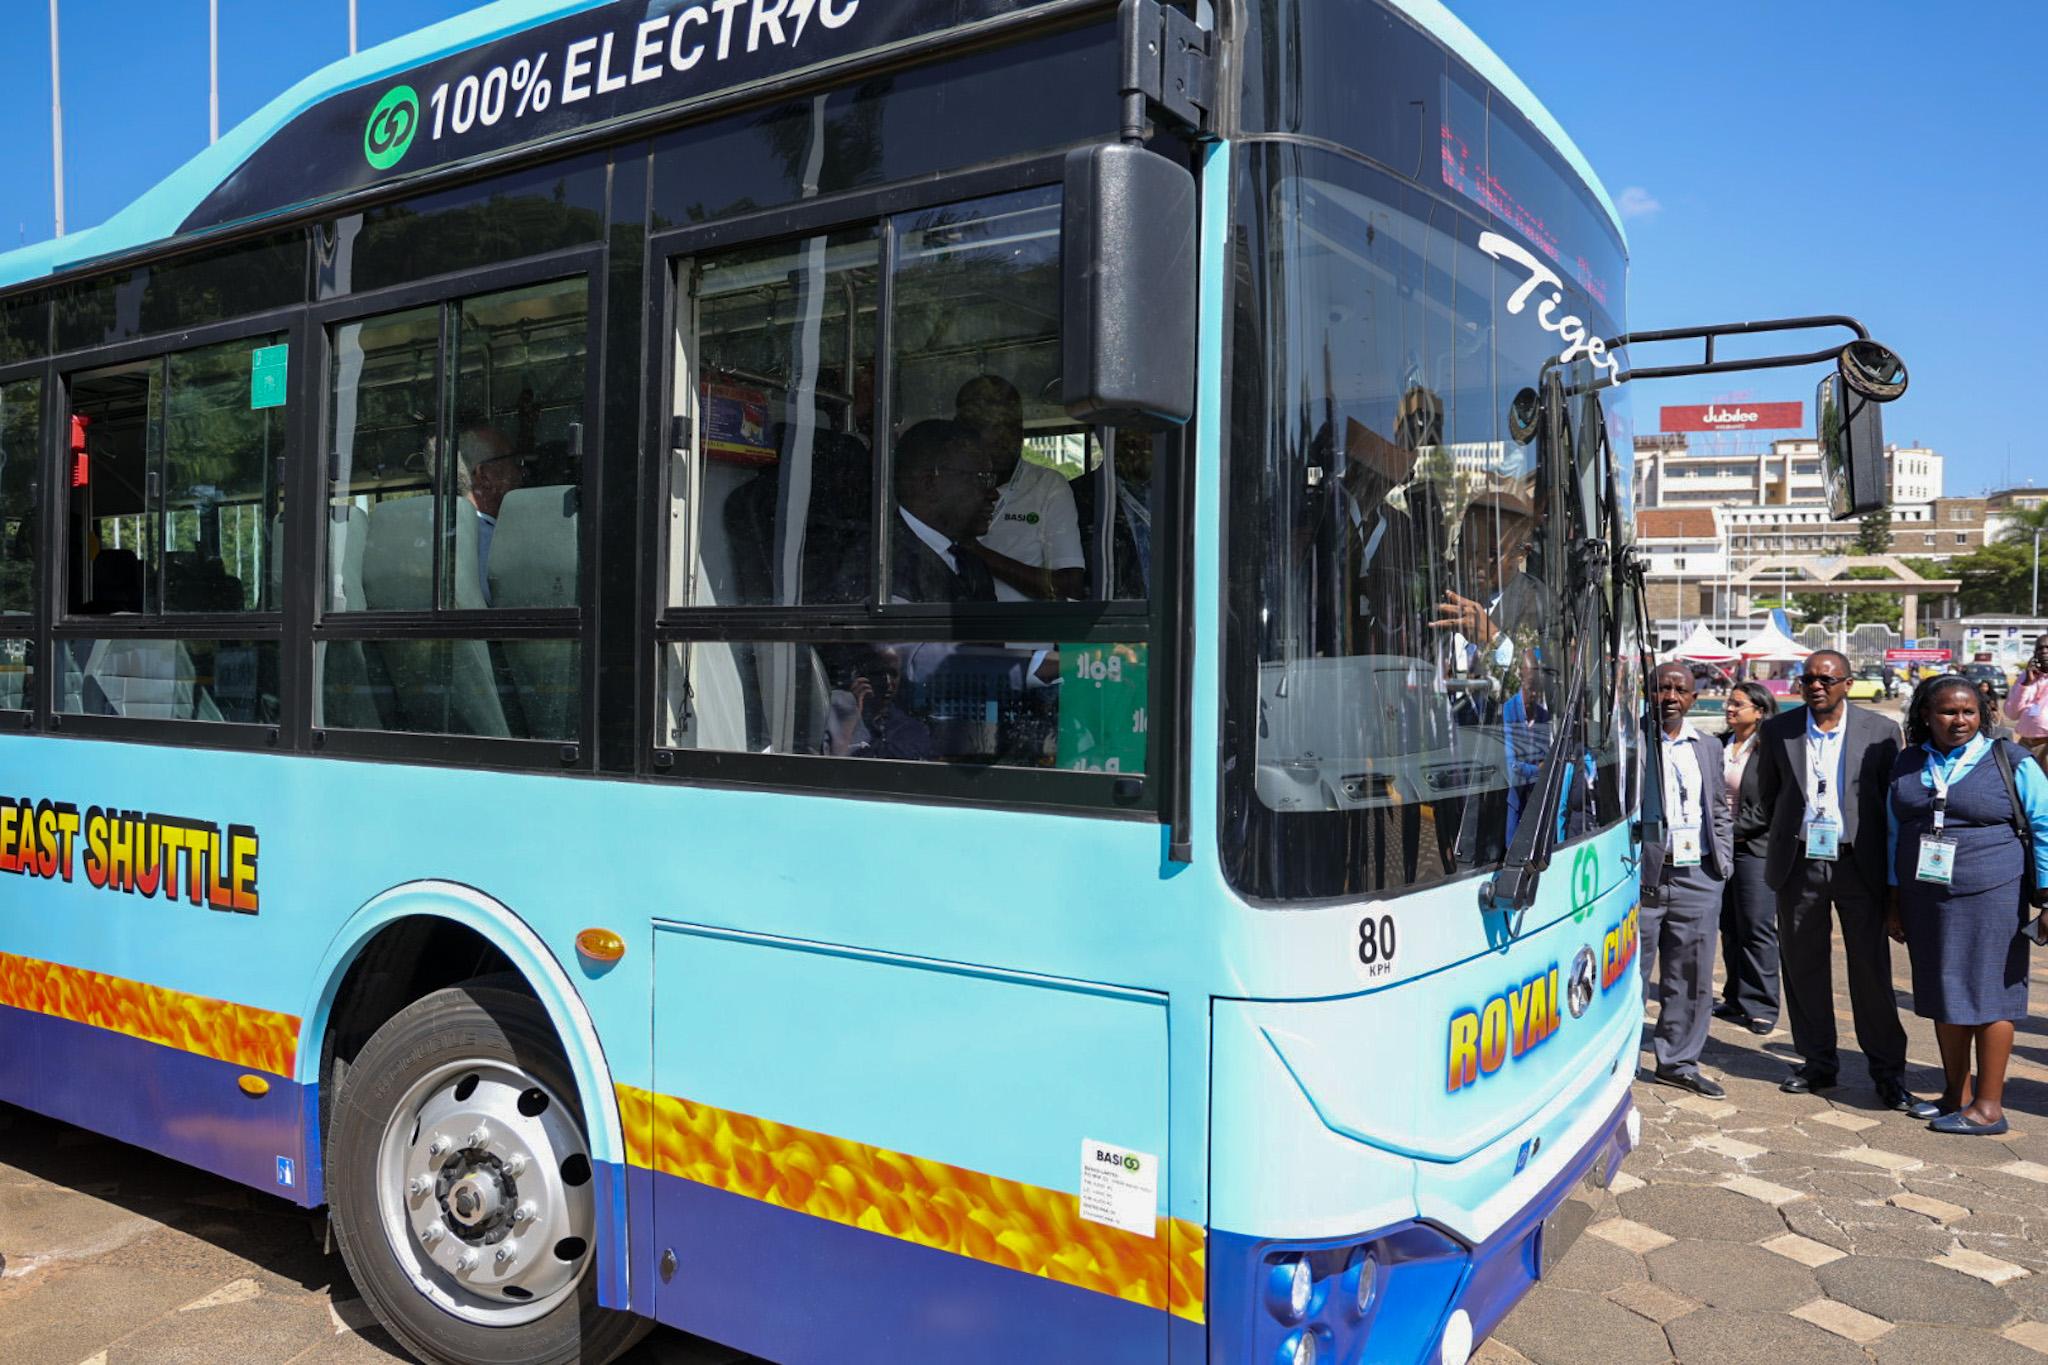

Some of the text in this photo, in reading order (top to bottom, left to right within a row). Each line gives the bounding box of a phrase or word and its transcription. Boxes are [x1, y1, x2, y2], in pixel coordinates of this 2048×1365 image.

[431, 52, 552, 140] 100%
[1479, 231, 1621, 387] Tiger
[1703, 405, 1759, 423] Jubilee
[0, 798, 258, 914] EAST SHUTTLE
[1359, 914, 1396, 964] 80
[1369, 964, 1391, 977] KPH
[1447, 967, 1562, 1093] ROYAL
